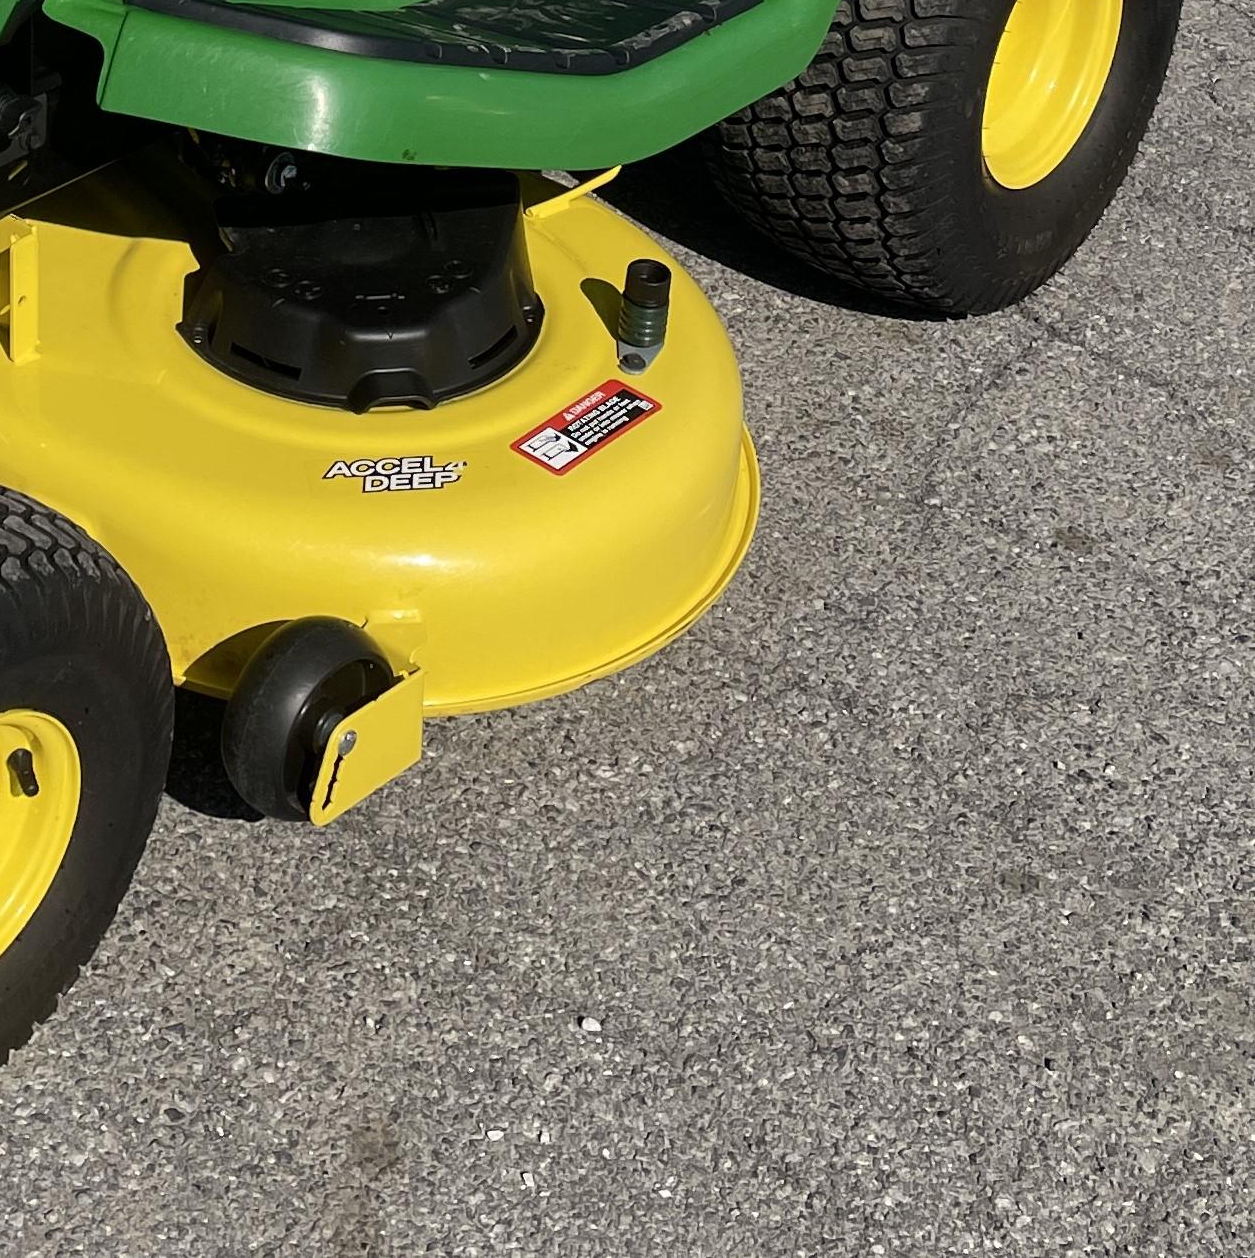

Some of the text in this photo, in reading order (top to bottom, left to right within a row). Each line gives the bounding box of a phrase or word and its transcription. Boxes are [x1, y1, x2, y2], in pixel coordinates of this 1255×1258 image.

[569, 391, 606, 416] DANGER
[322, 455, 446, 479] ACCEL
[362, 471, 462, 493] DEEP
